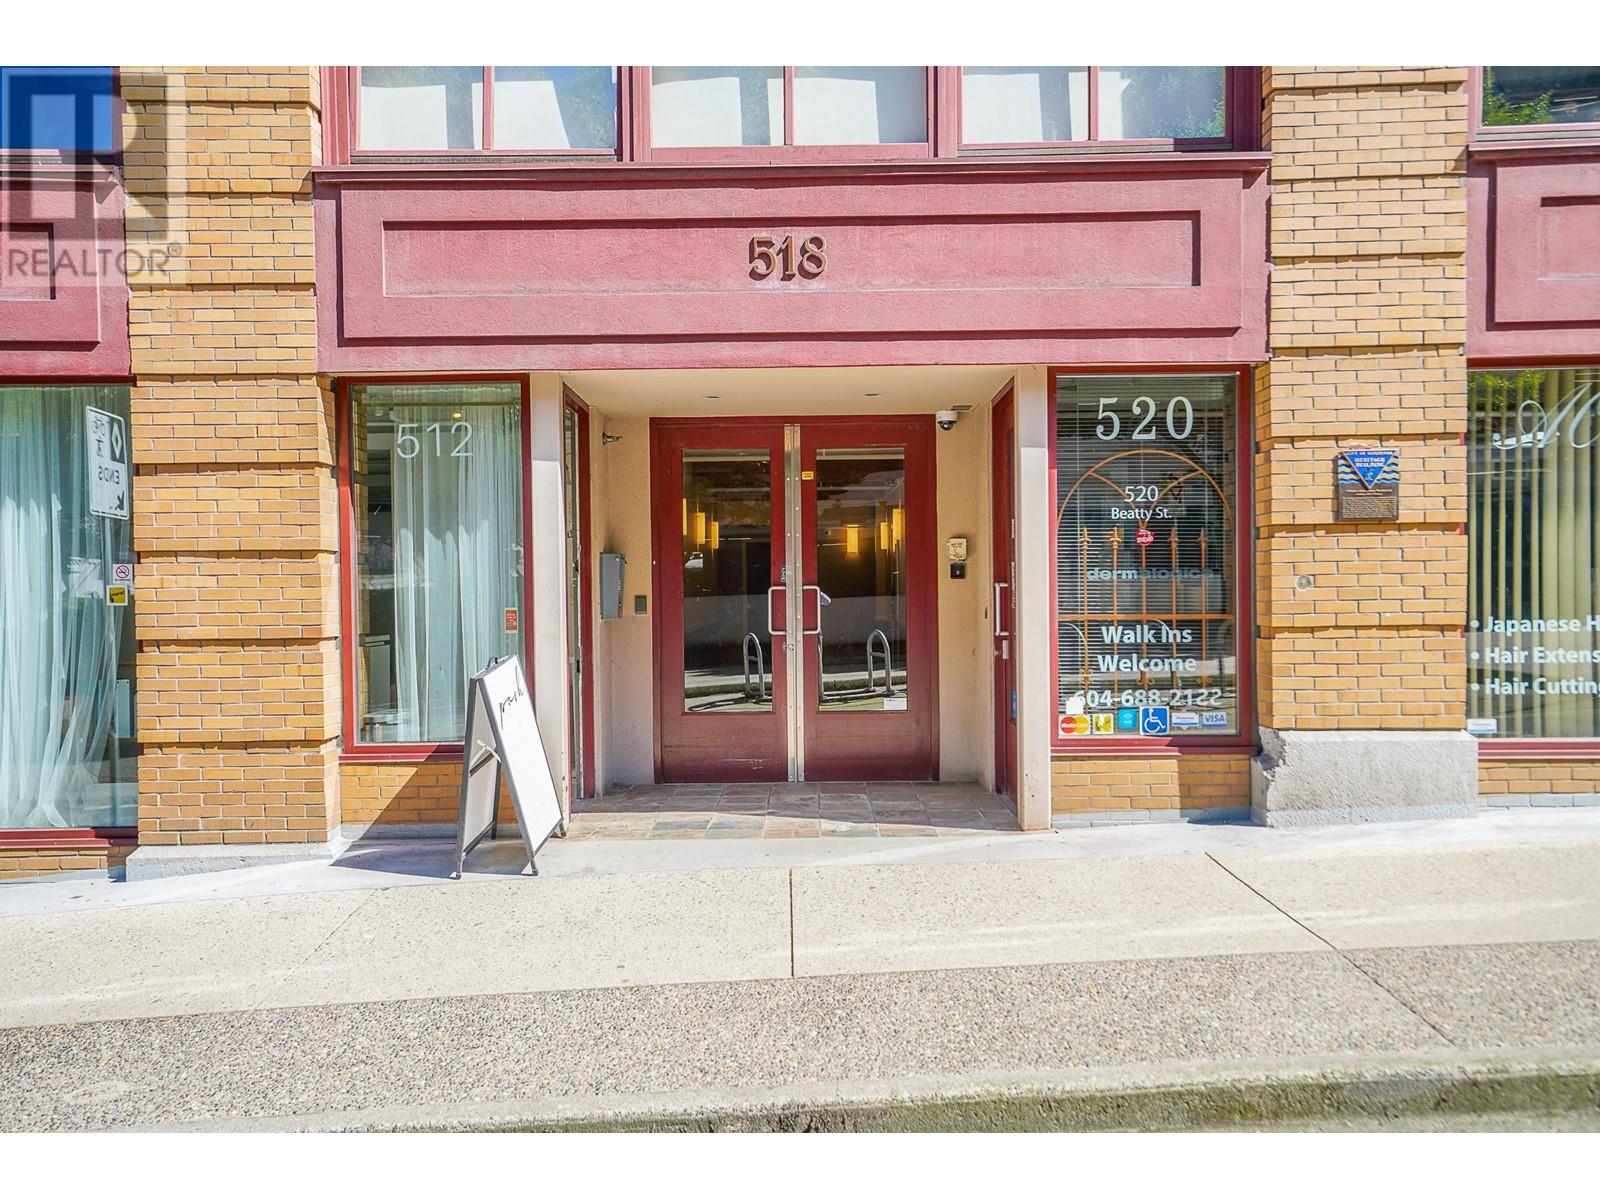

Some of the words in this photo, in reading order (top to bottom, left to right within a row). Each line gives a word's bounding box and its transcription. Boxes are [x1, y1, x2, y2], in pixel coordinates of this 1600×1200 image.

[749, 233, 828, 281] 518
[1095, 396, 1194, 440] 520
[396, 421, 474, 459] 512
[1124, 485, 1159, 502] 520
[1111, 507, 1153, 520] Beatty
[1155, 506, 1173, 519] St.
[1101, 624, 1157, 644] Walk
[1161, 624, 1193, 643] Ins
[1483, 616, 1581, 637] Japanese
[1097, 653, 1197, 673] Welcome
[1484, 646, 1529, 664] Hair
[1484, 677, 1529, 695] Hair
[1074, 689, 1222, 707] 604-688-2122
[1205, 714, 1225, 722] VISA
